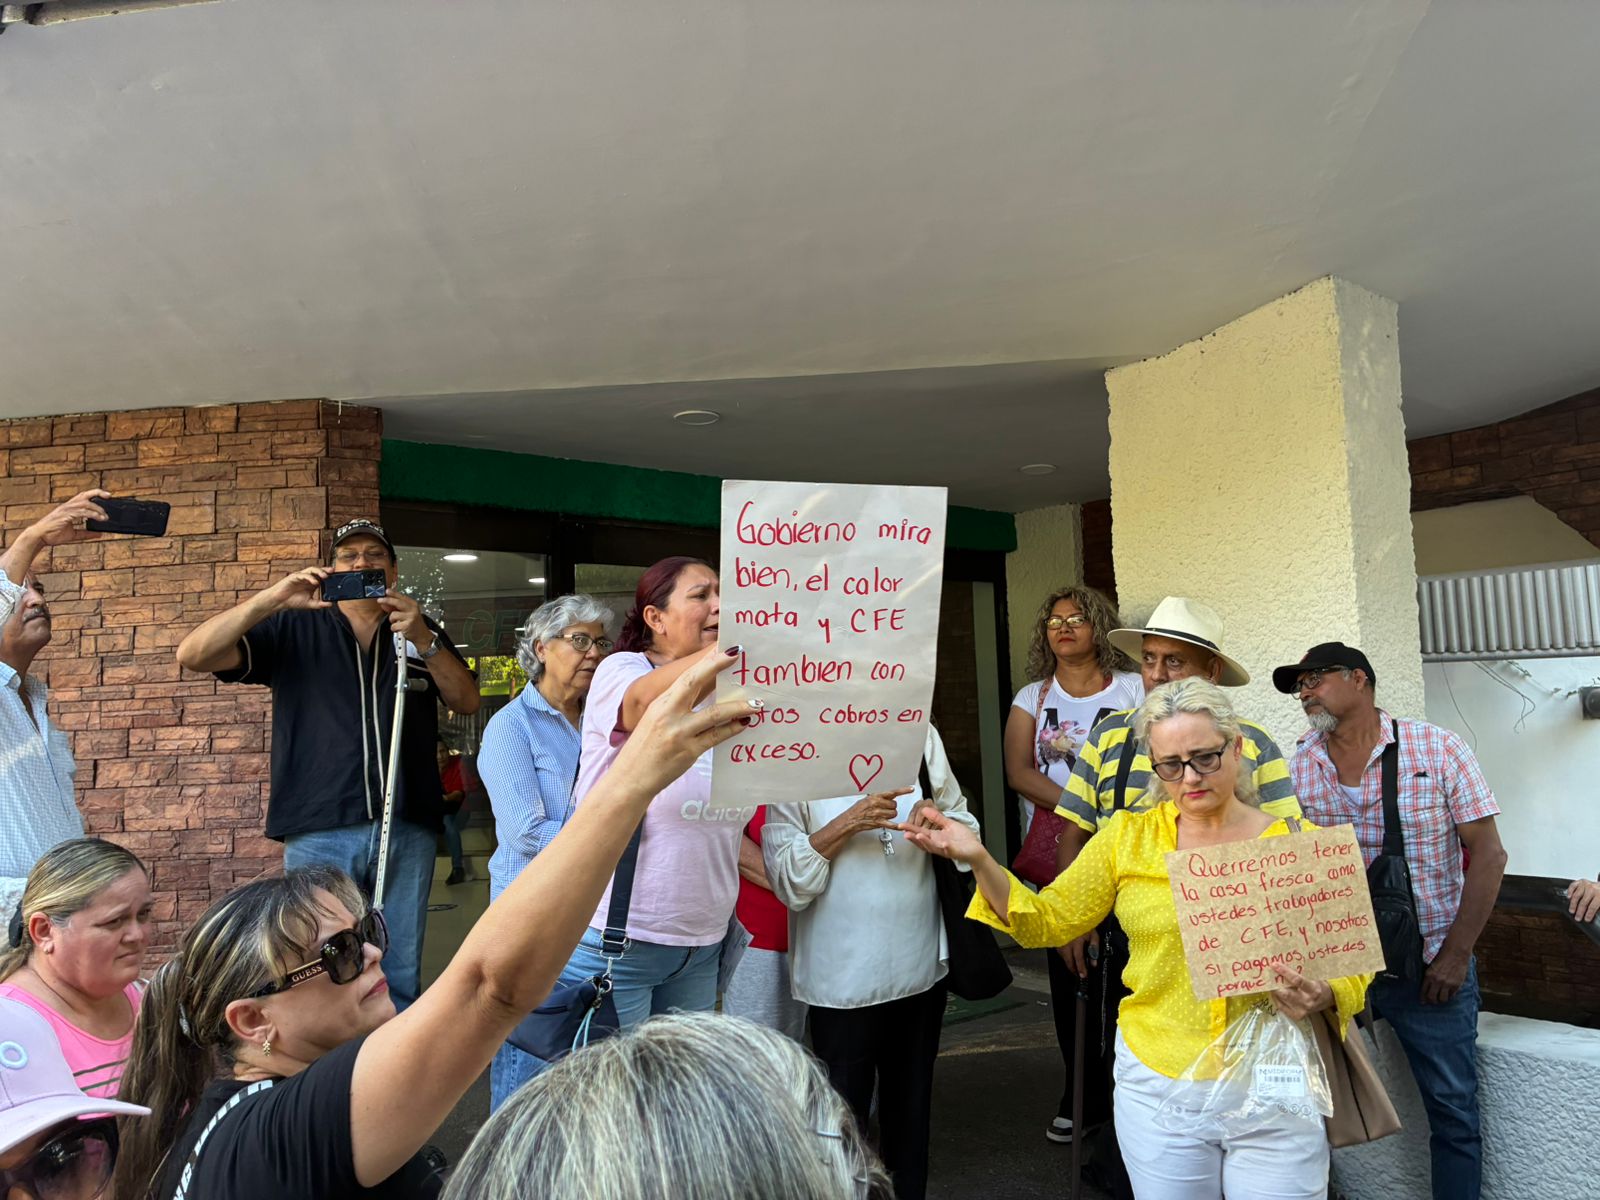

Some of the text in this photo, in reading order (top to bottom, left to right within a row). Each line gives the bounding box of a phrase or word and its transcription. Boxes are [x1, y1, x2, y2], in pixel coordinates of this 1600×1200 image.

[737, 501, 932, 546] Gobierno mira
[736, 557, 904, 596] bien, el calor
[735, 602, 906, 644] mata y CFE
[732, 651, 906, 687] tambien con
[746, 704, 923, 728] stos cobros en
[1188, 839, 1354, 879] Querremos tener
[1180, 863, 1357, 902] la casa fresca como
[1189, 886, 1354, 927] ustedes trabajadores
[1198, 935, 1221, 952] de
[1298, 925, 1310, 946] y
[1315, 911, 1369, 934] nosotros
[1308, 940, 1367, 960] ustedes
[291, 964, 323, 983] GUESS
[1217, 978, 1267, 998] porque
